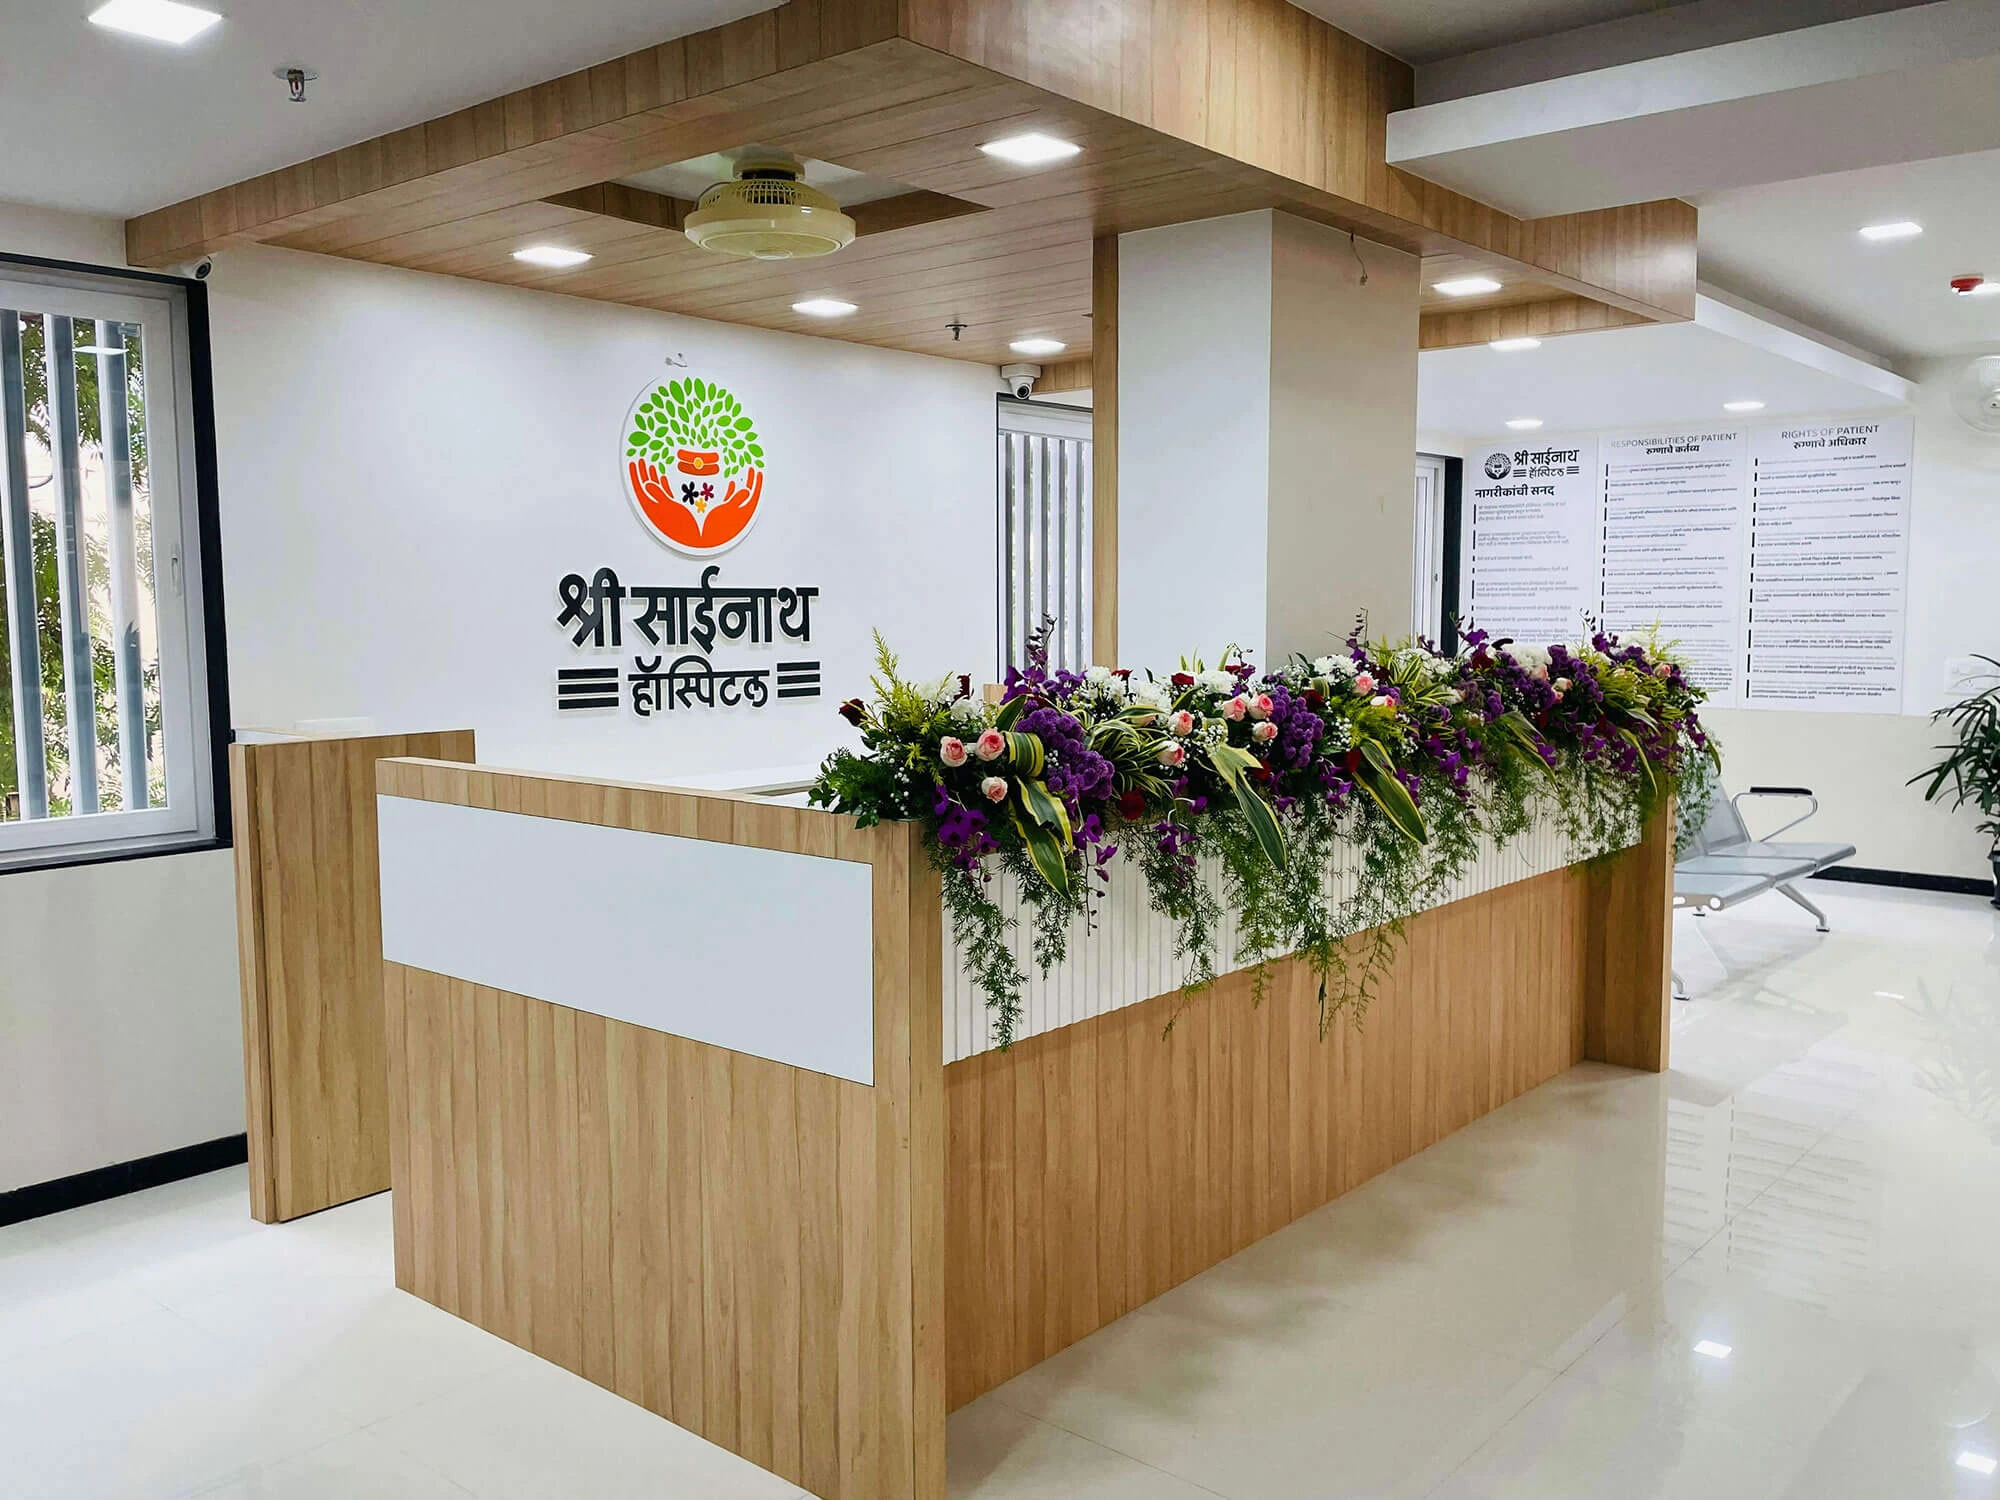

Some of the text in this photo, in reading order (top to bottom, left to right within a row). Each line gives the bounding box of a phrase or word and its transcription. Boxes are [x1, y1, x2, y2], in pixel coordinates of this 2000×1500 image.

[1781, 425, 1880, 439] RIGHTS OF PATIENT
[1611, 433, 1737, 448] RESPONSIBILITIES OF PATIENT
[1828, 436, 1867, 447] अधिकार
[1514, 447, 1580, 466] श्री साईनाथ
[1529, 466, 1565, 478] हॉस्पिटल
[1530, 485, 1555, 496] सनद
[557, 566, 819, 654] श्री साईनाथ
[628, 655, 770, 716] हॉस्पिटल
